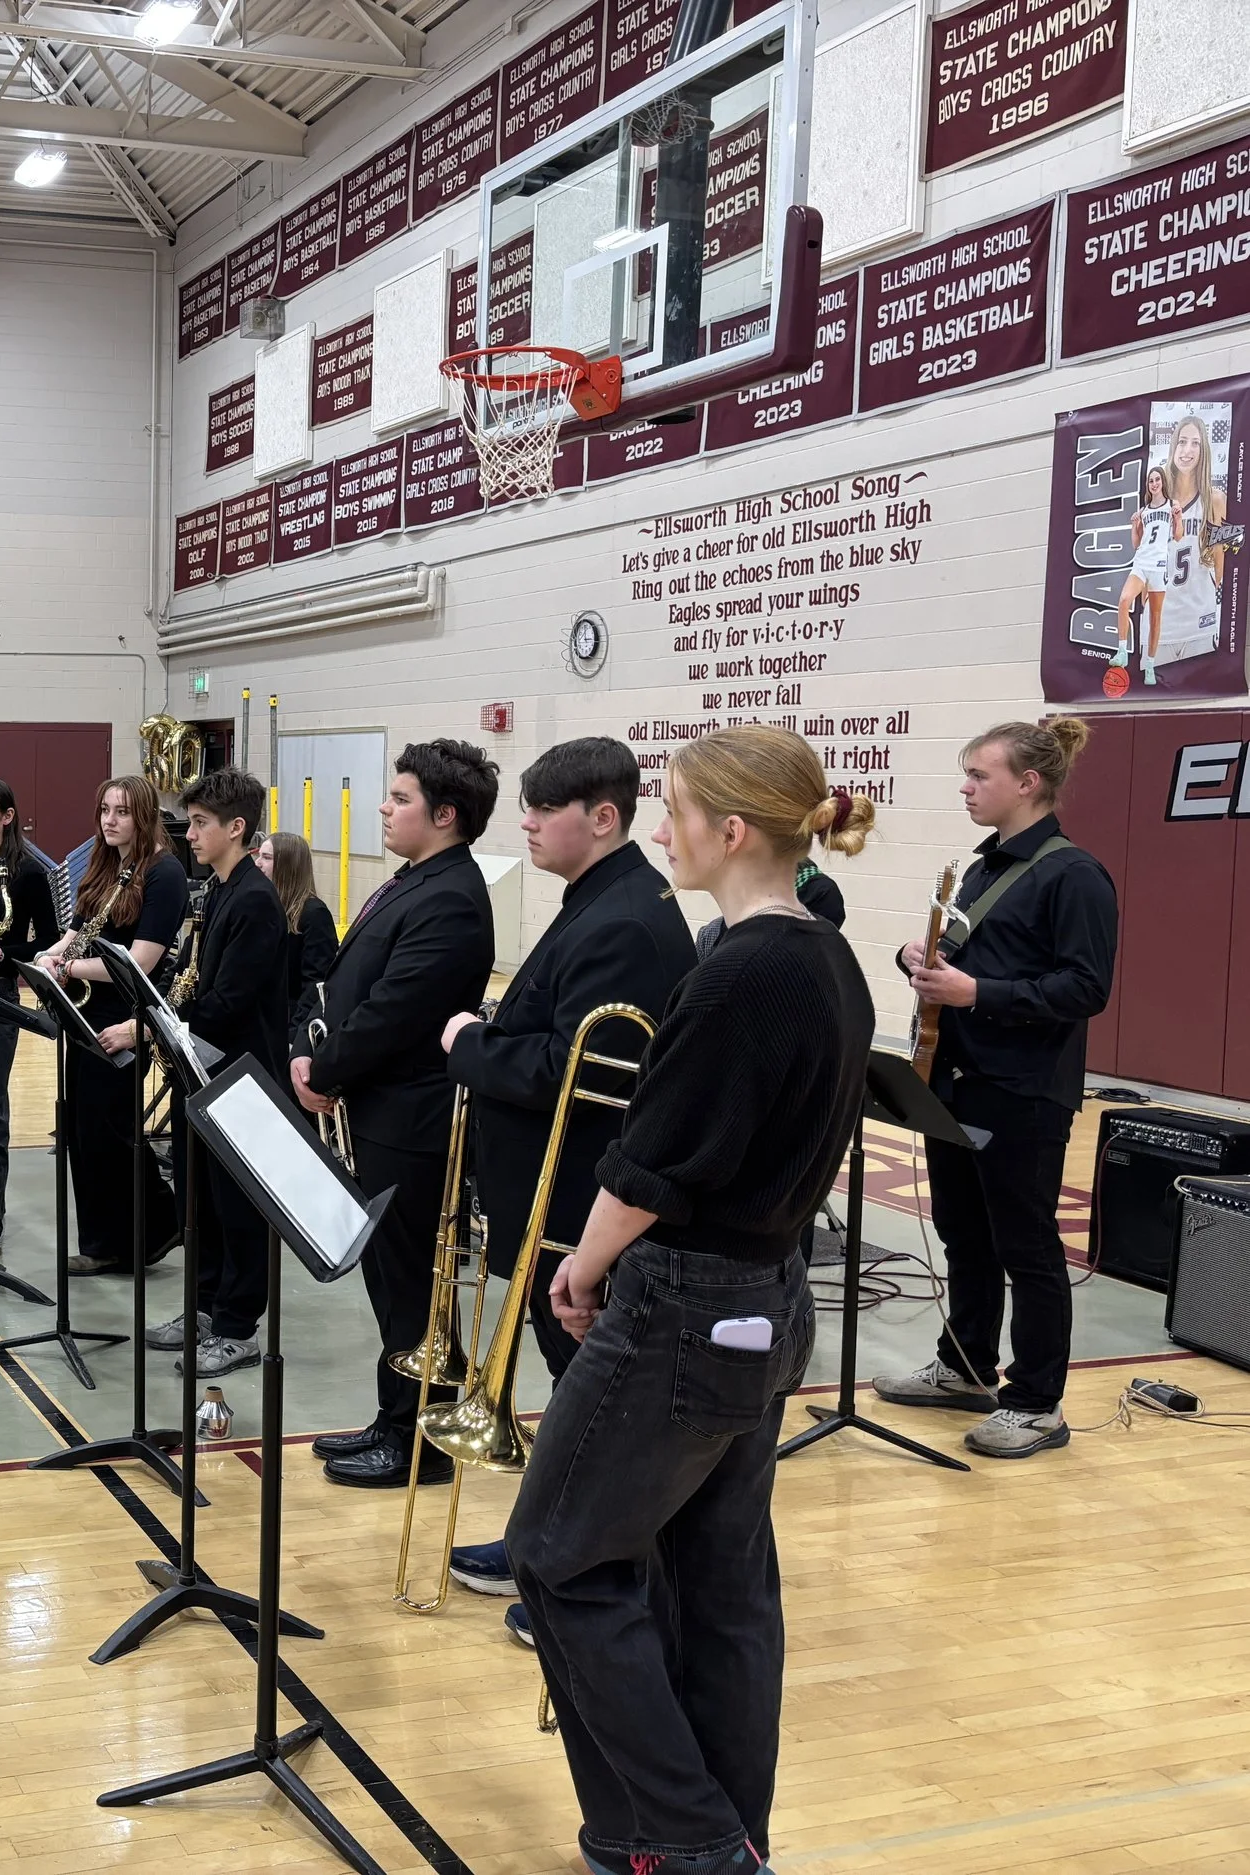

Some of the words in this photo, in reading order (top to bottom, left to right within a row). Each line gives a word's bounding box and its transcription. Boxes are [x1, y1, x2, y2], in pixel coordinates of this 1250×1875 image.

[617, 3, 649, 39] STATE
[944, 4, 1019, 50] ELLSWORTH
[510, 47, 546, 84] ELLSWORTH
[550, 35, 565, 57] HIGH
[569, 16, 594, 44] SCHOOL
[610, 39, 637, 72] GIRLS
[641, 17, 673, 52] CROSS
[510, 76, 536, 109] STATE
[540, 40, 594, 88] CHAMPIONS
[938, 89, 972, 125] BOYS
[981, 63, 1032, 107] CROSS
[1041, 20, 1117, 81] COUNTRY
[939, 41, 999, 86] STATE
[422, 112, 452, 142] ELLSWORTH
[455, 102, 467, 120] HIGH
[471, 86, 492, 110] SCHOOL
[506, 110, 525, 138] BOYS
[529, 92, 554, 122] CROSS
[558, 64, 596, 104] COUNTRY
[989, 92, 1049, 135] 1996
[422, 137, 444, 165] STATE
[447, 107, 492, 149] CHAMPIONS
[534, 114, 563, 143] 1977
[727, 128, 762, 158] SCHOOL
[389, 144, 407, 165] SCHOOL
[418, 168, 434, 190] BOYS
[438, 152, 458, 178] CROSS
[461, 130, 494, 163] COUNTRY
[348, 189, 367, 214] STATE
[370, 164, 406, 199] CHAMPIONS
[442, 171, 466, 196] 1976
[1088, 176, 1173, 225] ELLSWORTH
[1180, 161, 1217, 194] HIGH
[346, 215, 361, 236] BOYS
[365, 187, 406, 227] BASKETBALL
[286, 230, 302, 252] STATE
[305, 209, 336, 240] CHAMPIONS
[365, 221, 386, 243] 1966
[1084, 220, 1149, 265] STATE
[283, 253, 298, 273] BOYS
[301, 230, 338, 263] BASKETBALL
[508, 243, 531, 266] SCHOOL
[881, 253, 946, 293] ELLSWORTH
[951, 242, 978, 269] HIGH
[983, 225, 1031, 259] SCHOOL
[1111, 231, 1250, 297] CHEERING
[231, 268, 246, 287] STATE
[301, 260, 320, 280] 1964
[877, 290, 927, 328] STATE
[933, 257, 1031, 311] CHAMPIONS
[1137, 284, 1217, 326] 2024
[183, 300, 195, 317] STATE
[869, 331, 915, 366] GIRLS
[922, 295, 1034, 351] BASKETBALL
[318, 359, 336, 378] STATE
[339, 342, 373, 369] CHAMPIONS
[918, 349, 977, 384] 2023
[317, 381, 331, 398] BOYS
[333, 374, 351, 393] INDOOR
[354, 364, 371, 385] TRACK
[211, 410, 226, 429] STATE
[228, 399, 254, 422] CHAMPIONS
[334, 393, 353, 411] 1989
[754, 400, 802, 429] 2023
[212, 431, 227, 447] BOYS
[229, 418, 253, 439] SOCCER
[413, 434, 442, 453] ELLSWORTH
[444, 428, 456, 441] HIGH
[380, 447, 398, 463] SCHOOL
[411, 452, 434, 475] STATE
[626, 437, 663, 461] 2022
[339, 479, 360, 498] STATE
[362, 467, 397, 491] CHAMPIONS
[406, 482, 426, 499] GIRLS
[428, 477, 448, 495] CROSS
[279, 500, 296, 517] STATE
[335, 501, 359, 519] BOYS
[362, 489, 396, 513] SWIMMING
[430, 496, 454, 514] 2018
[735, 497, 772, 524] High
[780, 482, 839, 515] School
[226, 520, 240, 535] STATE
[242, 509, 269, 530] CHAMPIONS
[280, 510, 324, 537] WRESTLING
[357, 517, 377, 533] 2016
[622, 552, 649, 574] Let's
[653, 548, 680, 573] give
[683, 547, 691, 563] a
[696, 538, 733, 561] cheer
[736, 532, 758, 556] for
[762, 526, 785, 549] old
[791, 509, 876, 545] Ellsworth
[885, 499, 932, 530] High
[1149, 525, 1159, 544] 5
[179, 536, 191, 550] STATE
[226, 539, 236, 553] BOYS
[294, 536, 310, 551] 2015
[1069, 425, 1144, 653] BAGLEY
[188, 548, 206, 564] GOLF
[632, 580, 663, 601] Ring
[669, 574, 690, 595] out
[695, 570, 717, 591] the
[723, 563, 772, 588] echoes
[777, 556, 814, 579] from
[820, 549, 844, 572] the
[849, 544, 884, 568] blue
[889, 538, 922, 564] sky
[1173, 546, 1192, 586] 5
[669, 602, 710, 626] Eagles
[715, 593, 762, 622] spread
[768, 591, 804, 619] your
[809, 583, 860, 608] wings
[1231, 567, 1239, 619] ELLSWORTH
[674, 631, 697, 652] and
[702, 629, 722, 653] fly
[725, 628, 748, 647] for
[1082, 649, 1111, 660] SENIOR
[688, 663, 708, 681] we
[716, 657, 753, 677] work
[759, 652, 827, 680] together
[702, 692, 721, 710] we
[727, 690, 771, 708] never
[775, 684, 802, 705] fall
[628, 722, 648, 740] old
[803, 714, 835, 736] win
[840, 717, 879, 736] over
[886, 711, 910, 735] all
[824, 747, 836, 769] it
[843, 745, 890, 774] right
[224, 1344, 236, 1356] N
